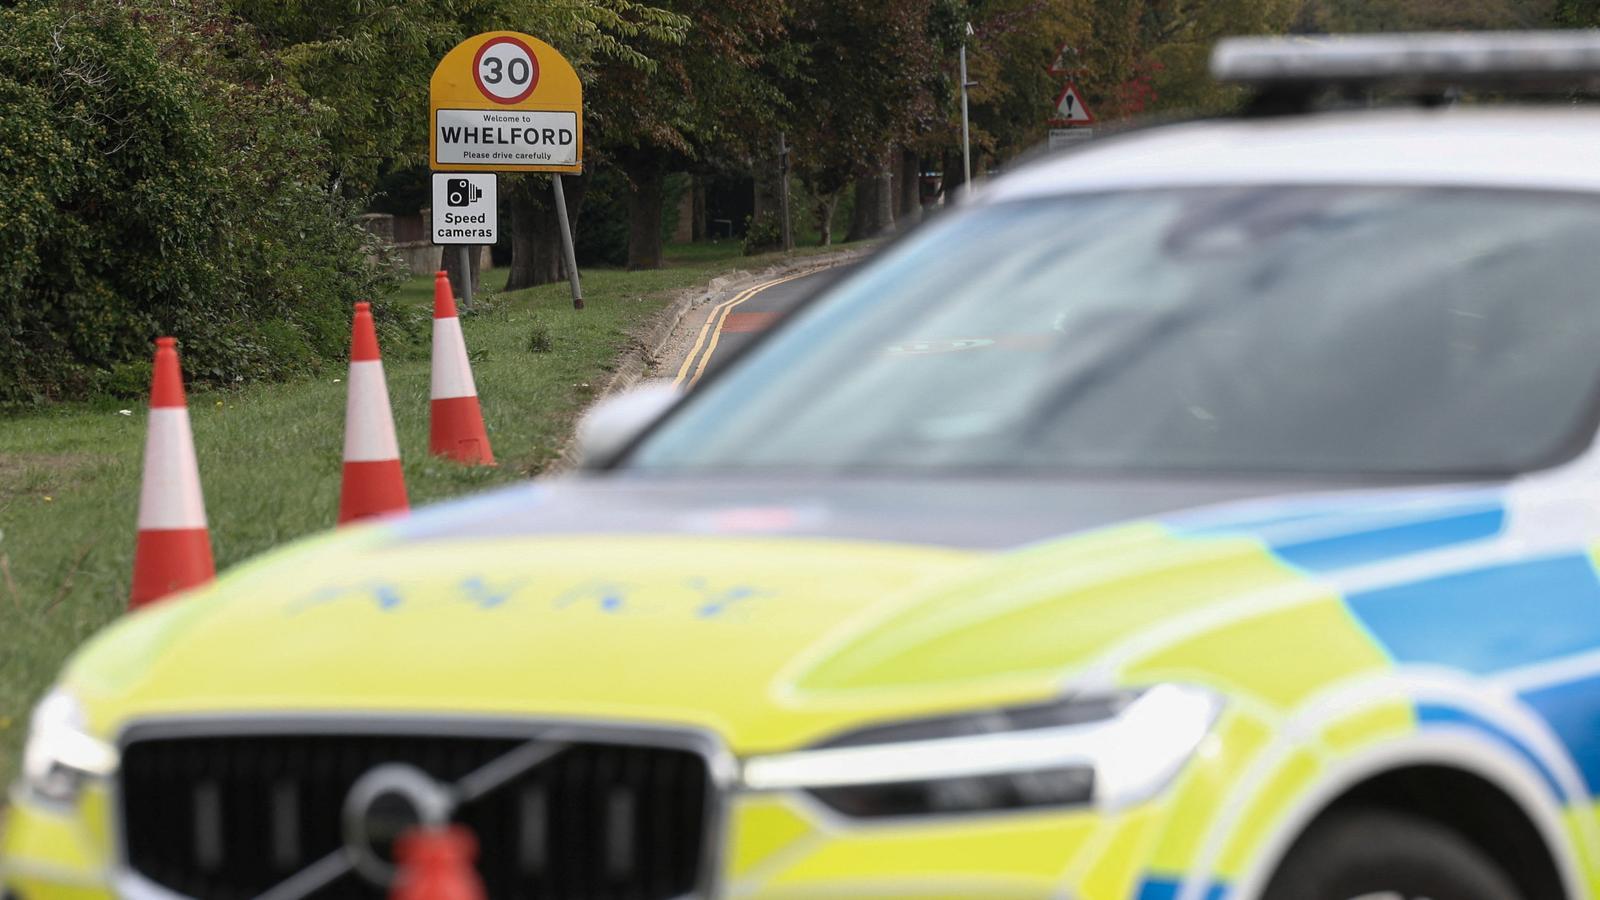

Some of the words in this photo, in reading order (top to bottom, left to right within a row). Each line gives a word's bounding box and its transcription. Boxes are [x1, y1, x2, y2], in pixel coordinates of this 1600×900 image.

[483, 57, 529, 85] 30
[483, 115, 520, 123] Welcome
[523, 115, 531, 123] to
[441, 127, 573, 146] WHELFORD
[463, 151, 490, 159] Please
[492, 152, 513, 160] drive
[515, 152, 552, 162] carefully
[445, 213, 486, 225] Speed
[438, 229, 492, 237] cameras
